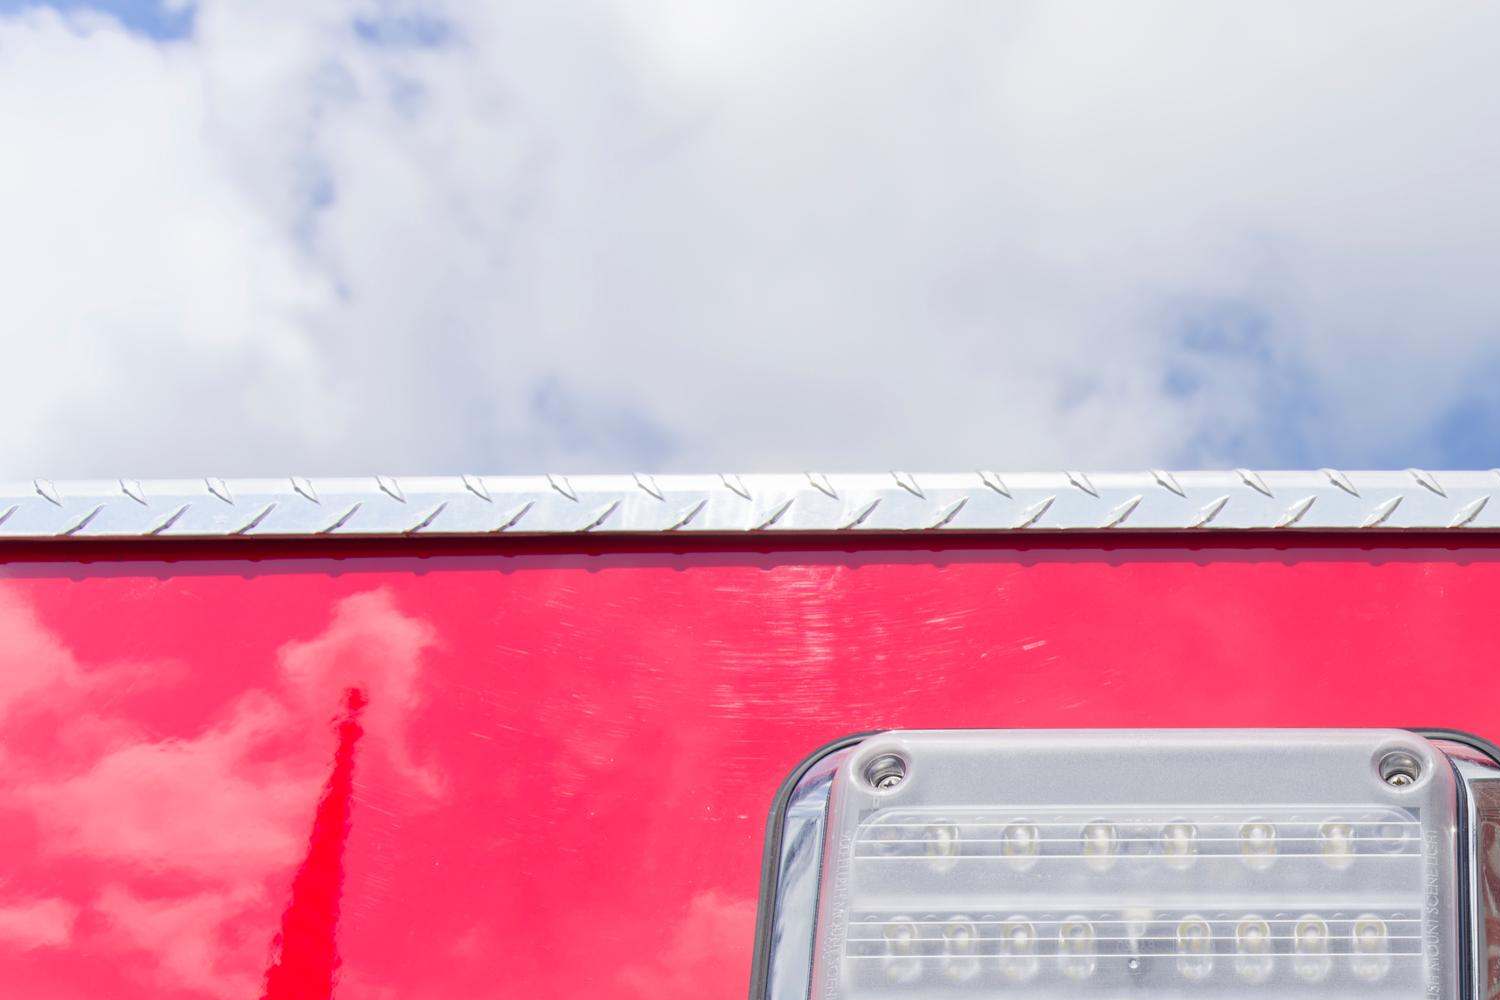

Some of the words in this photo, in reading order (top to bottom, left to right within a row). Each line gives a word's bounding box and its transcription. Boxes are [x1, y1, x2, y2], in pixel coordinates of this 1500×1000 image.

[1425, 830, 1438, 866] LIGHT
[1425, 869, 1439, 915] SCENE
[1425, 919, 1440, 971] MOUNT
